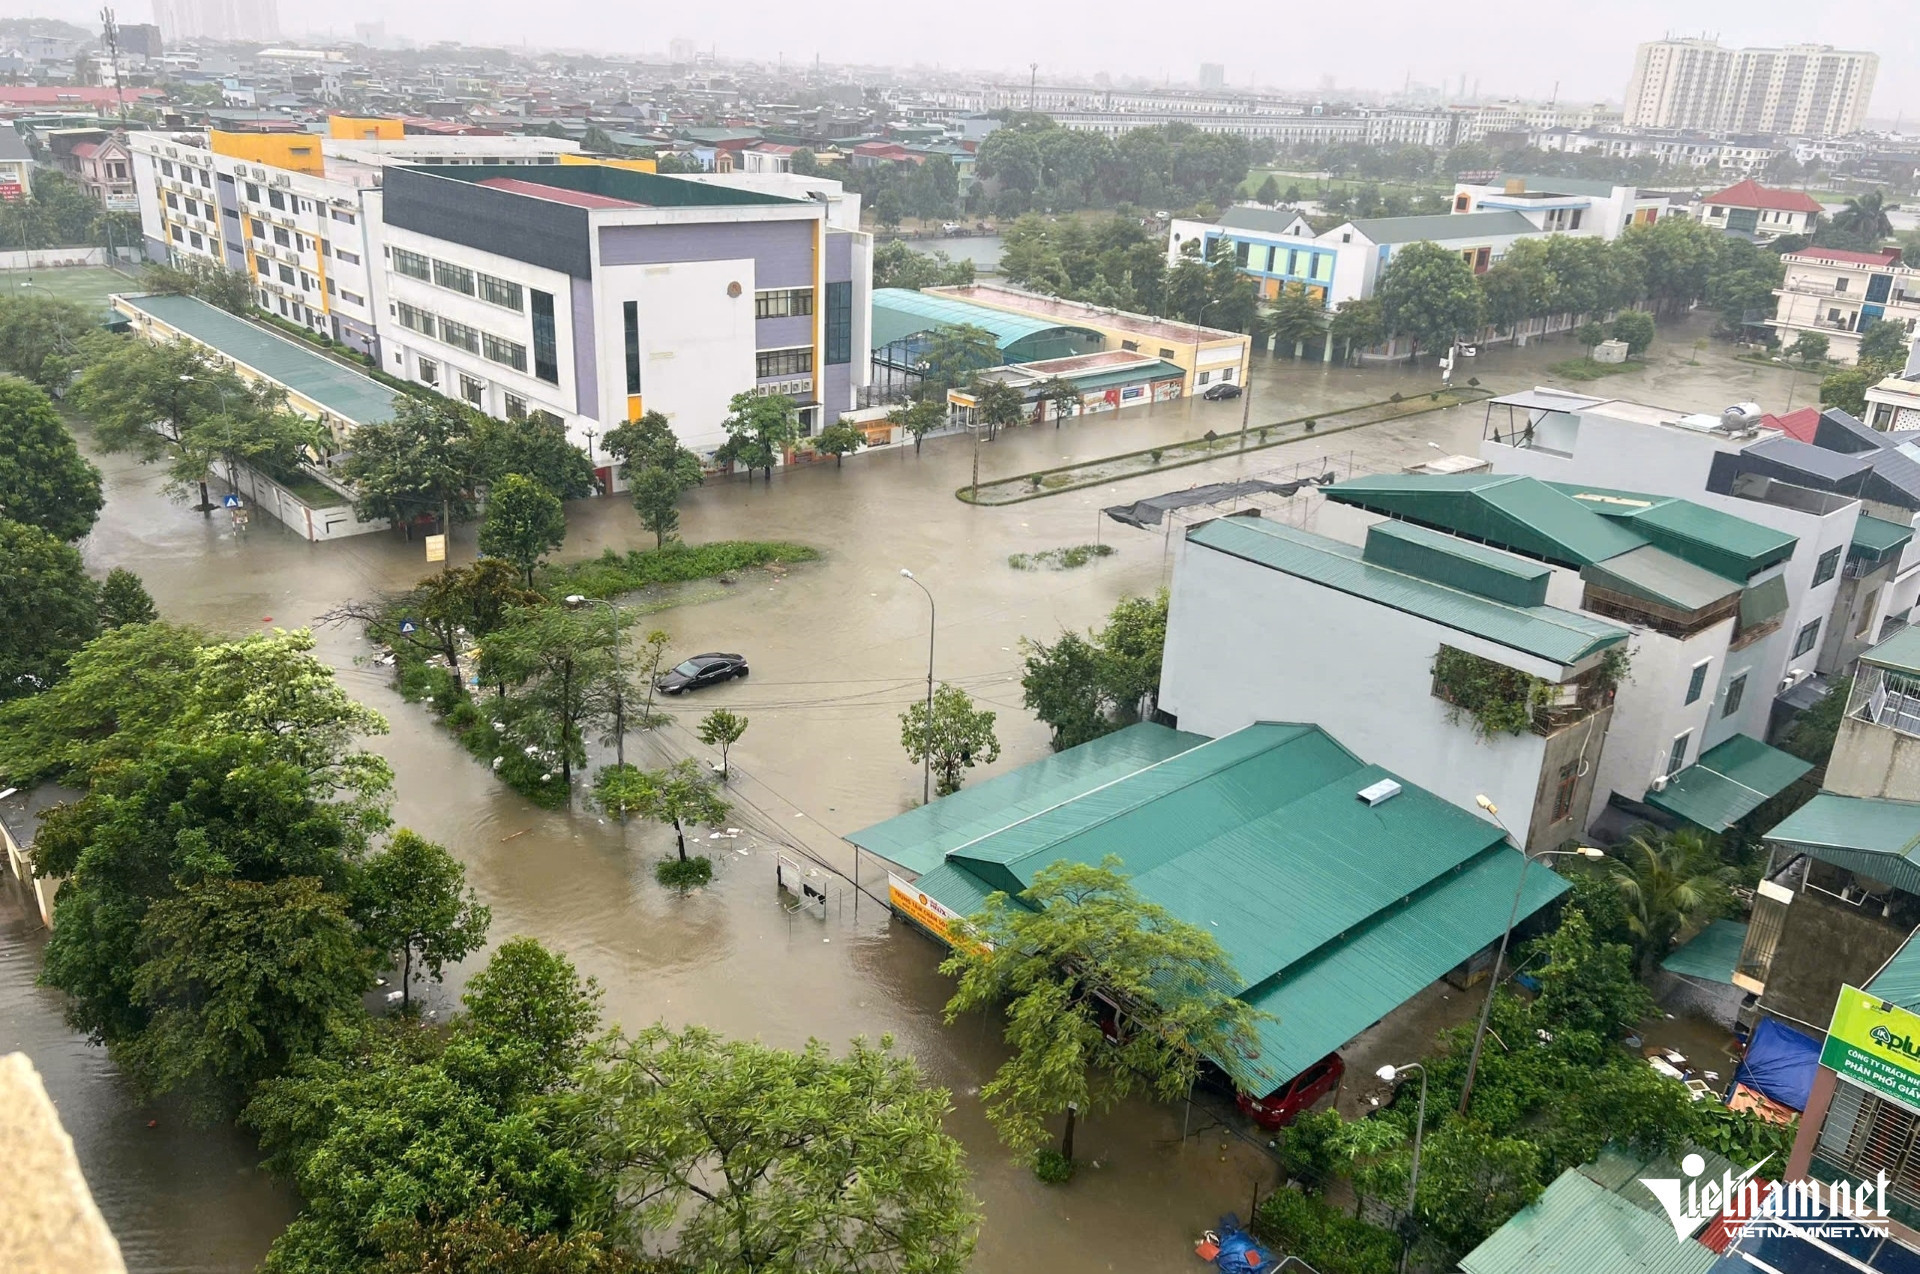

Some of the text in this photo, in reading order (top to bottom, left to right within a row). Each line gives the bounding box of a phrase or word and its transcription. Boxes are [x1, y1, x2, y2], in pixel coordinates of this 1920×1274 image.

[1887, 1034, 1920, 1057] plu
[1844, 1059, 1871, 1077] PHÂN
[1872, 1073, 1897, 1089] PHỐI
[1847, 1050, 1920, 1088] CÔNG TY TRÁCH NH
